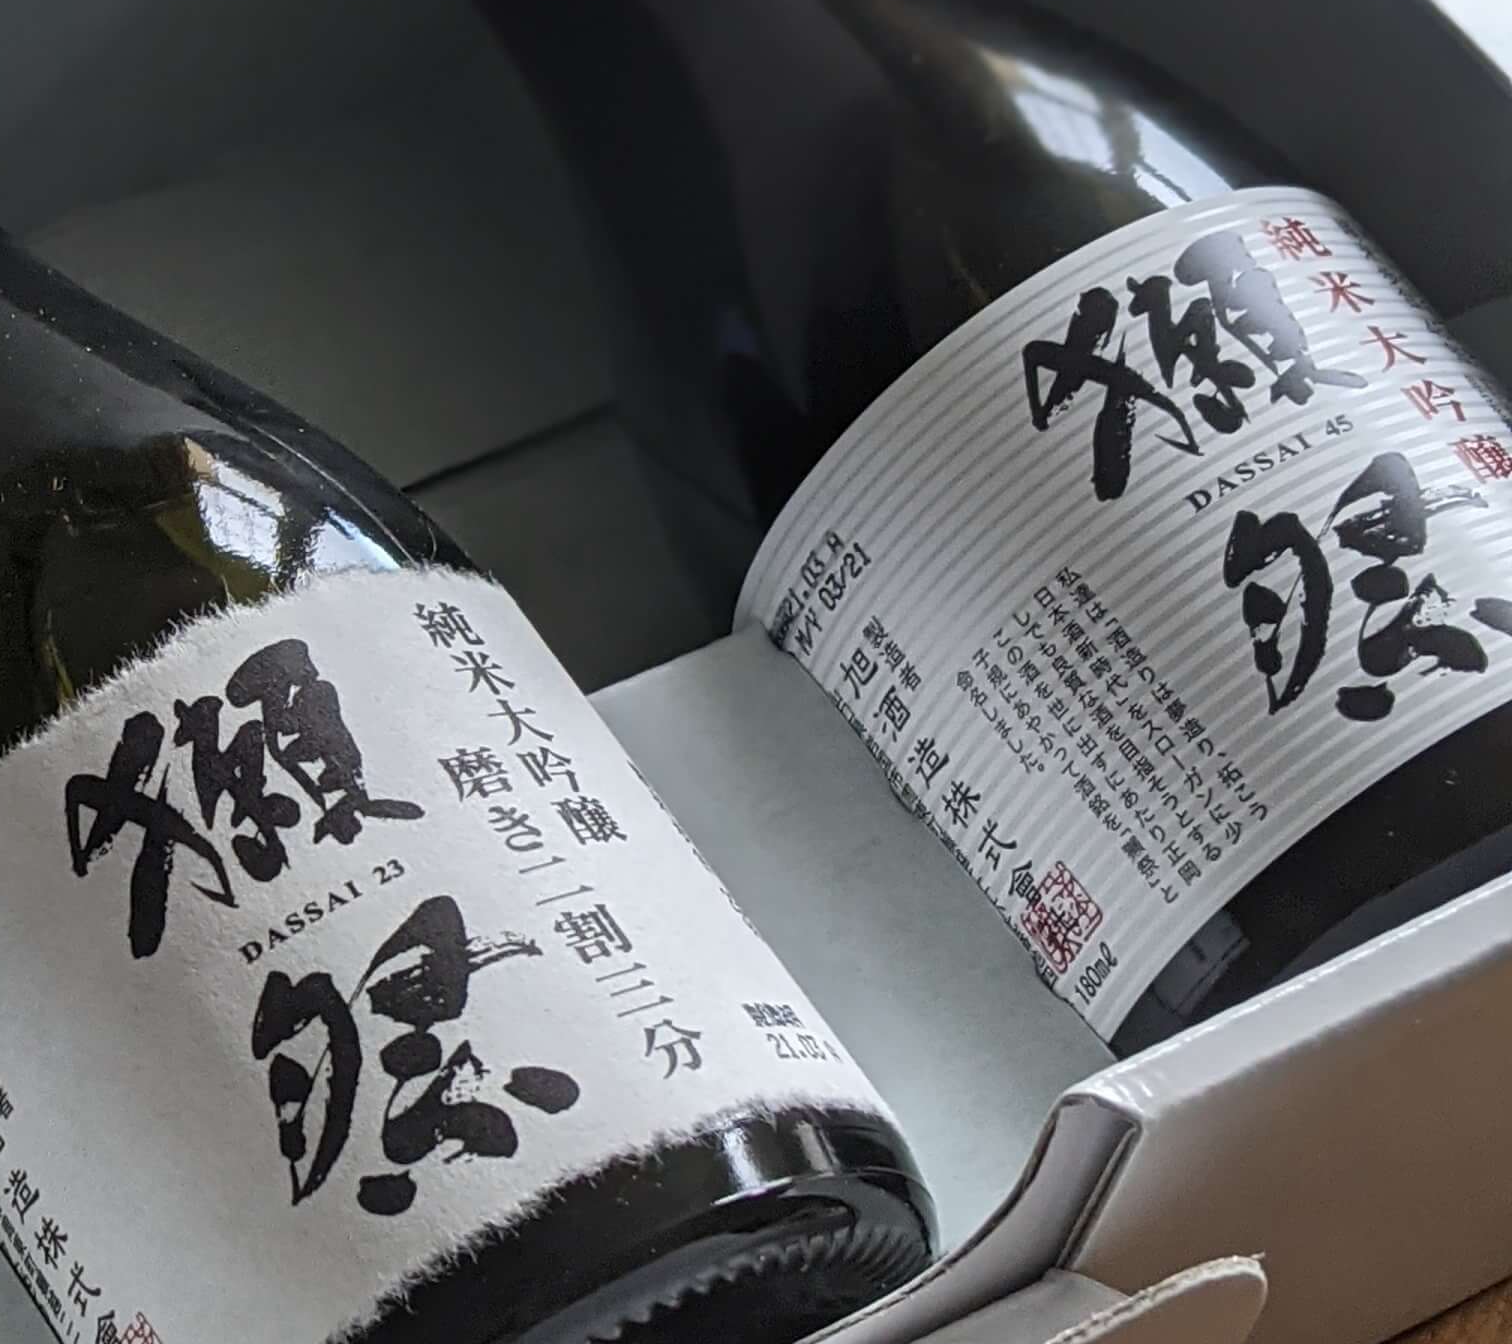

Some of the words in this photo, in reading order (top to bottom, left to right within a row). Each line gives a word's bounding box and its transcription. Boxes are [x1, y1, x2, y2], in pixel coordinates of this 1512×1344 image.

[1184, 431, 1313, 514] DASSAI
[1324, 413, 1357, 439] 45
[1259, 216, 1512, 485] 純米大吟醸
[817, 541, 872, 612] 03/21
[861, 614, 922, 692] 製造者
[411, 601, 628, 846] 純米大吟醸
[955, 669, 1046, 775] 命名しました。
[990, 627, 1202, 886] この酒を世に出すにあたり正岡
[1010, 603, 1222, 863] しでも良質な酒を目指そうとする
[1032, 584, 1243, 845] 日本酒新時代」をスローガンに少
[236, 878, 364, 965] DASSAI
[372, 857, 407, 887] 23
[437, 745, 703, 1080] 磨き二割三分
